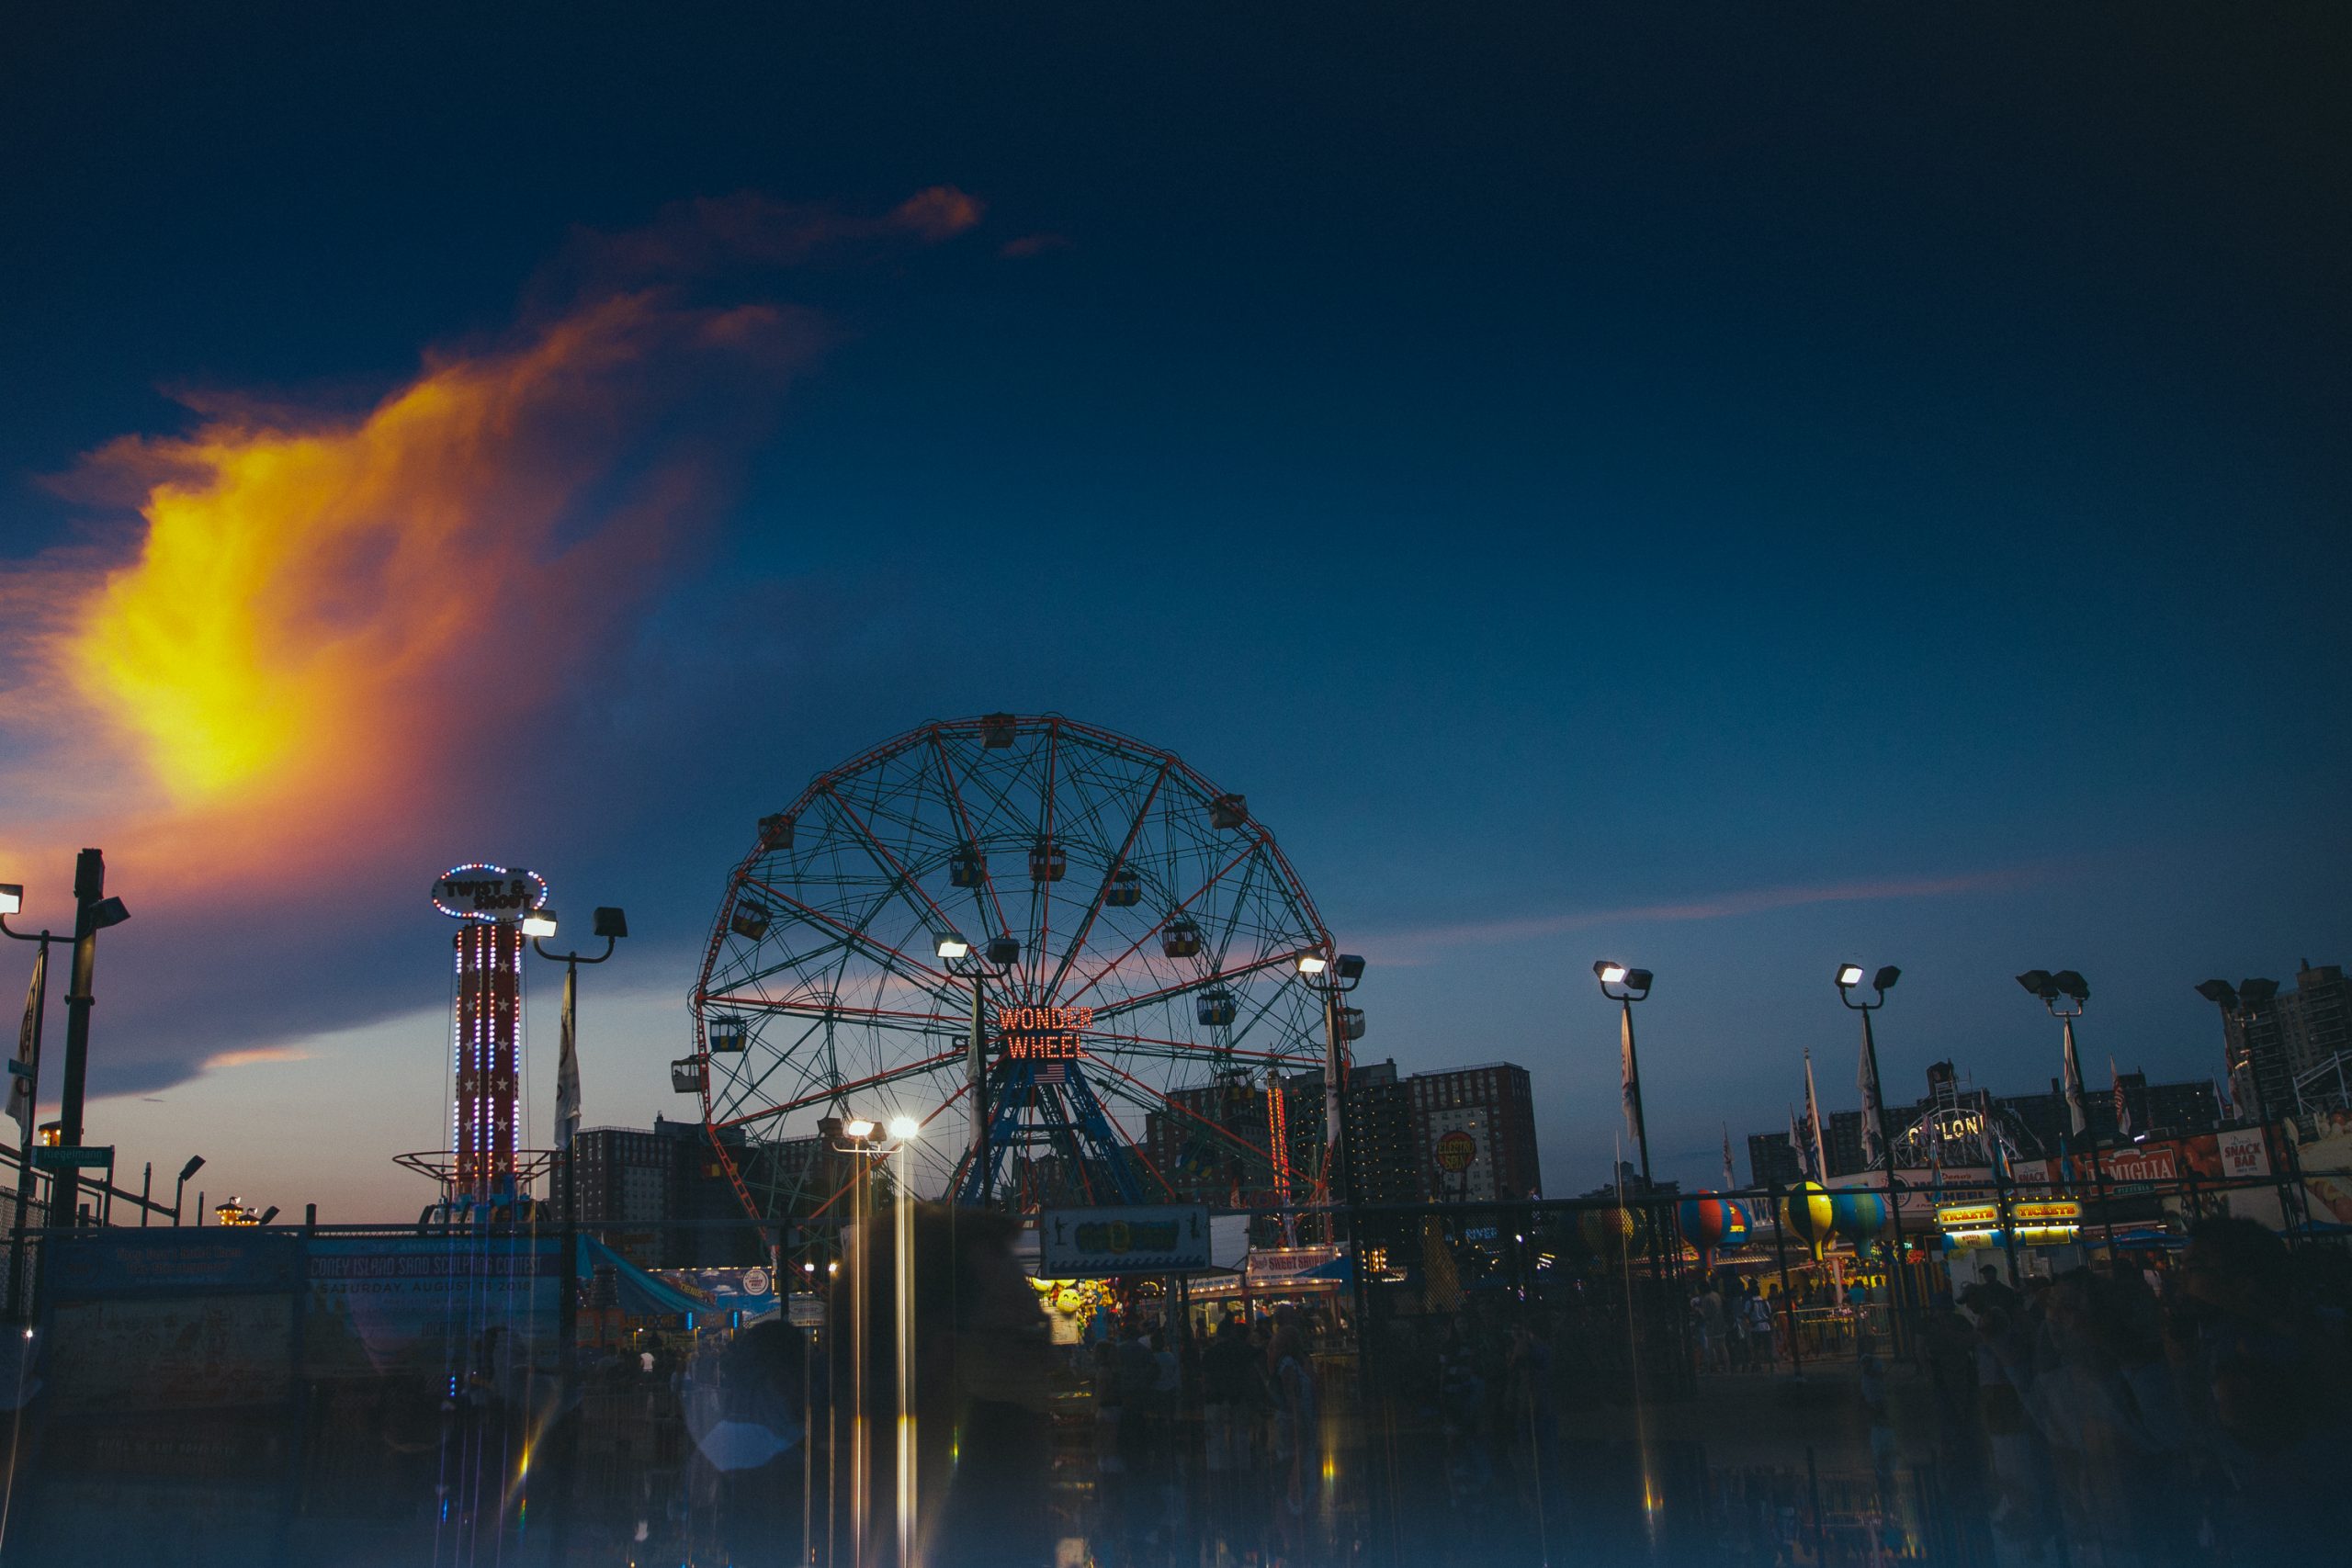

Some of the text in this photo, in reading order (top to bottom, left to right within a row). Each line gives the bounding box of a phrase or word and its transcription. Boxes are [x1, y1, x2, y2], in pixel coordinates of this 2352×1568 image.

[443, 880, 526, 897] TWIST &
[1000, 1007, 1092, 1030] WONDER
[1008, 1036, 1090, 1058] WHEEL
[1908, 1114, 1984, 1145] CLON
[1438, 1139, 1474, 1155] ELECTRO
[2224, 1143, 2261, 1157] SNACK
[44, 1148, 102, 1161] Riegelmann
[2234, 1155, 2256, 1168] BAR
[1444, 1156, 1466, 1168] SPIN
[2088, 1158, 2174, 1182] MIGLIA
[1941, 1209, 1995, 1222] TICKETS
[2018, 1205, 2075, 1217] TICKETS
[311, 1258, 349, 1276] CONEY
[352, 1257, 393, 1276] ISLAND
[398, 1256, 428, 1275] SAND
[494, 1255, 542, 1274] CONTEST
[1269, 1256, 1296, 1270] SWEET
[412, 1283, 470, 1292] AUGUST
[496, 1282, 531, 1292] 2018
